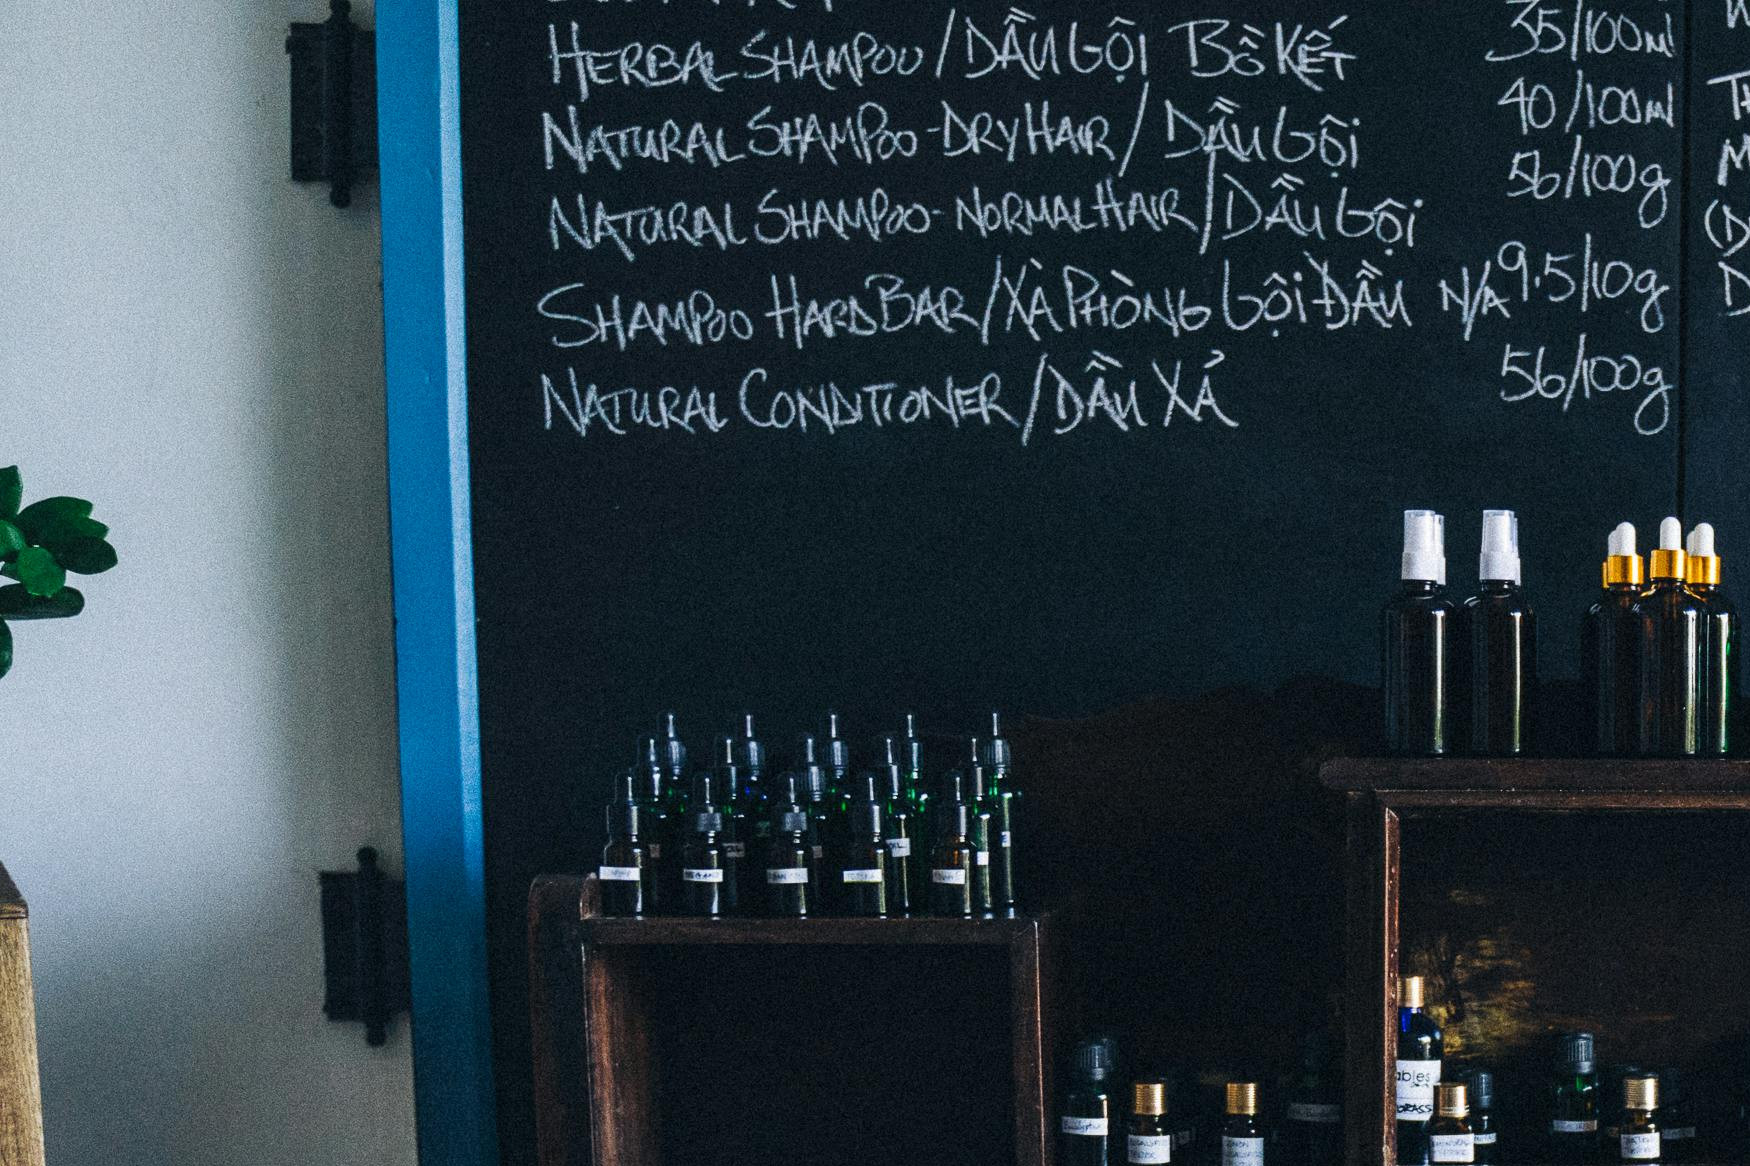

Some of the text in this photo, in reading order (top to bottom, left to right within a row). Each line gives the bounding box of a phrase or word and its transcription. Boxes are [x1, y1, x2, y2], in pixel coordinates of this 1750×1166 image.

[549, 20, 738, 101] HERBAL
[542, 103, 745, 173] NATURAL
[549, 193, 746, 262] NATURAL
[537, 282, 752, 352] SHAMPOO
[1063, 263, 1211, 338] PHÒNG
[542, 366, 730, 437] NATURAL
